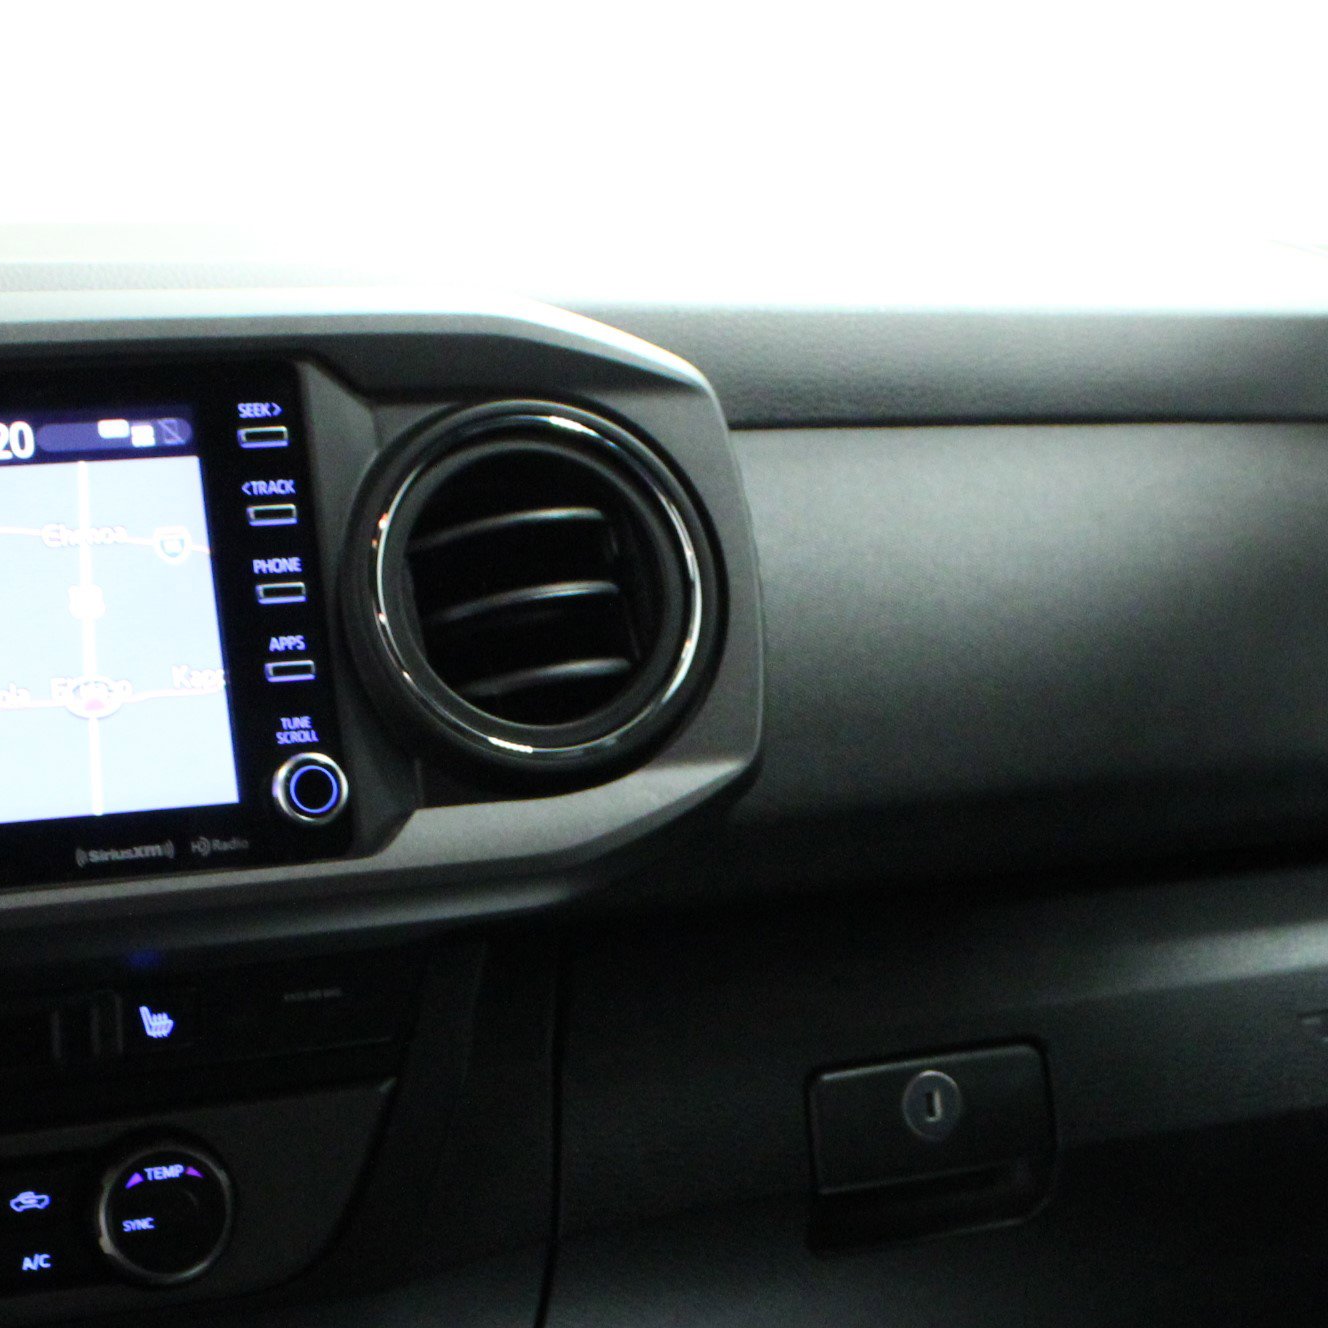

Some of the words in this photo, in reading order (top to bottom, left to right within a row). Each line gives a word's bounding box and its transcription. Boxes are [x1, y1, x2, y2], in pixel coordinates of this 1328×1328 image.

[237, 402, 271, 419] SEEK
[252, 556, 303, 575] PHONE
[268, 634, 308, 653] APPS
[280, 716, 312, 731] TUNE
[275, 728, 320, 745] SCROLL
[212, 837, 250, 852] Radio
[143, 1163, 185, 1183] TEMP
[121, 1216, 156, 1233] SYNC
[21, 1253, 52, 1271] A/C
